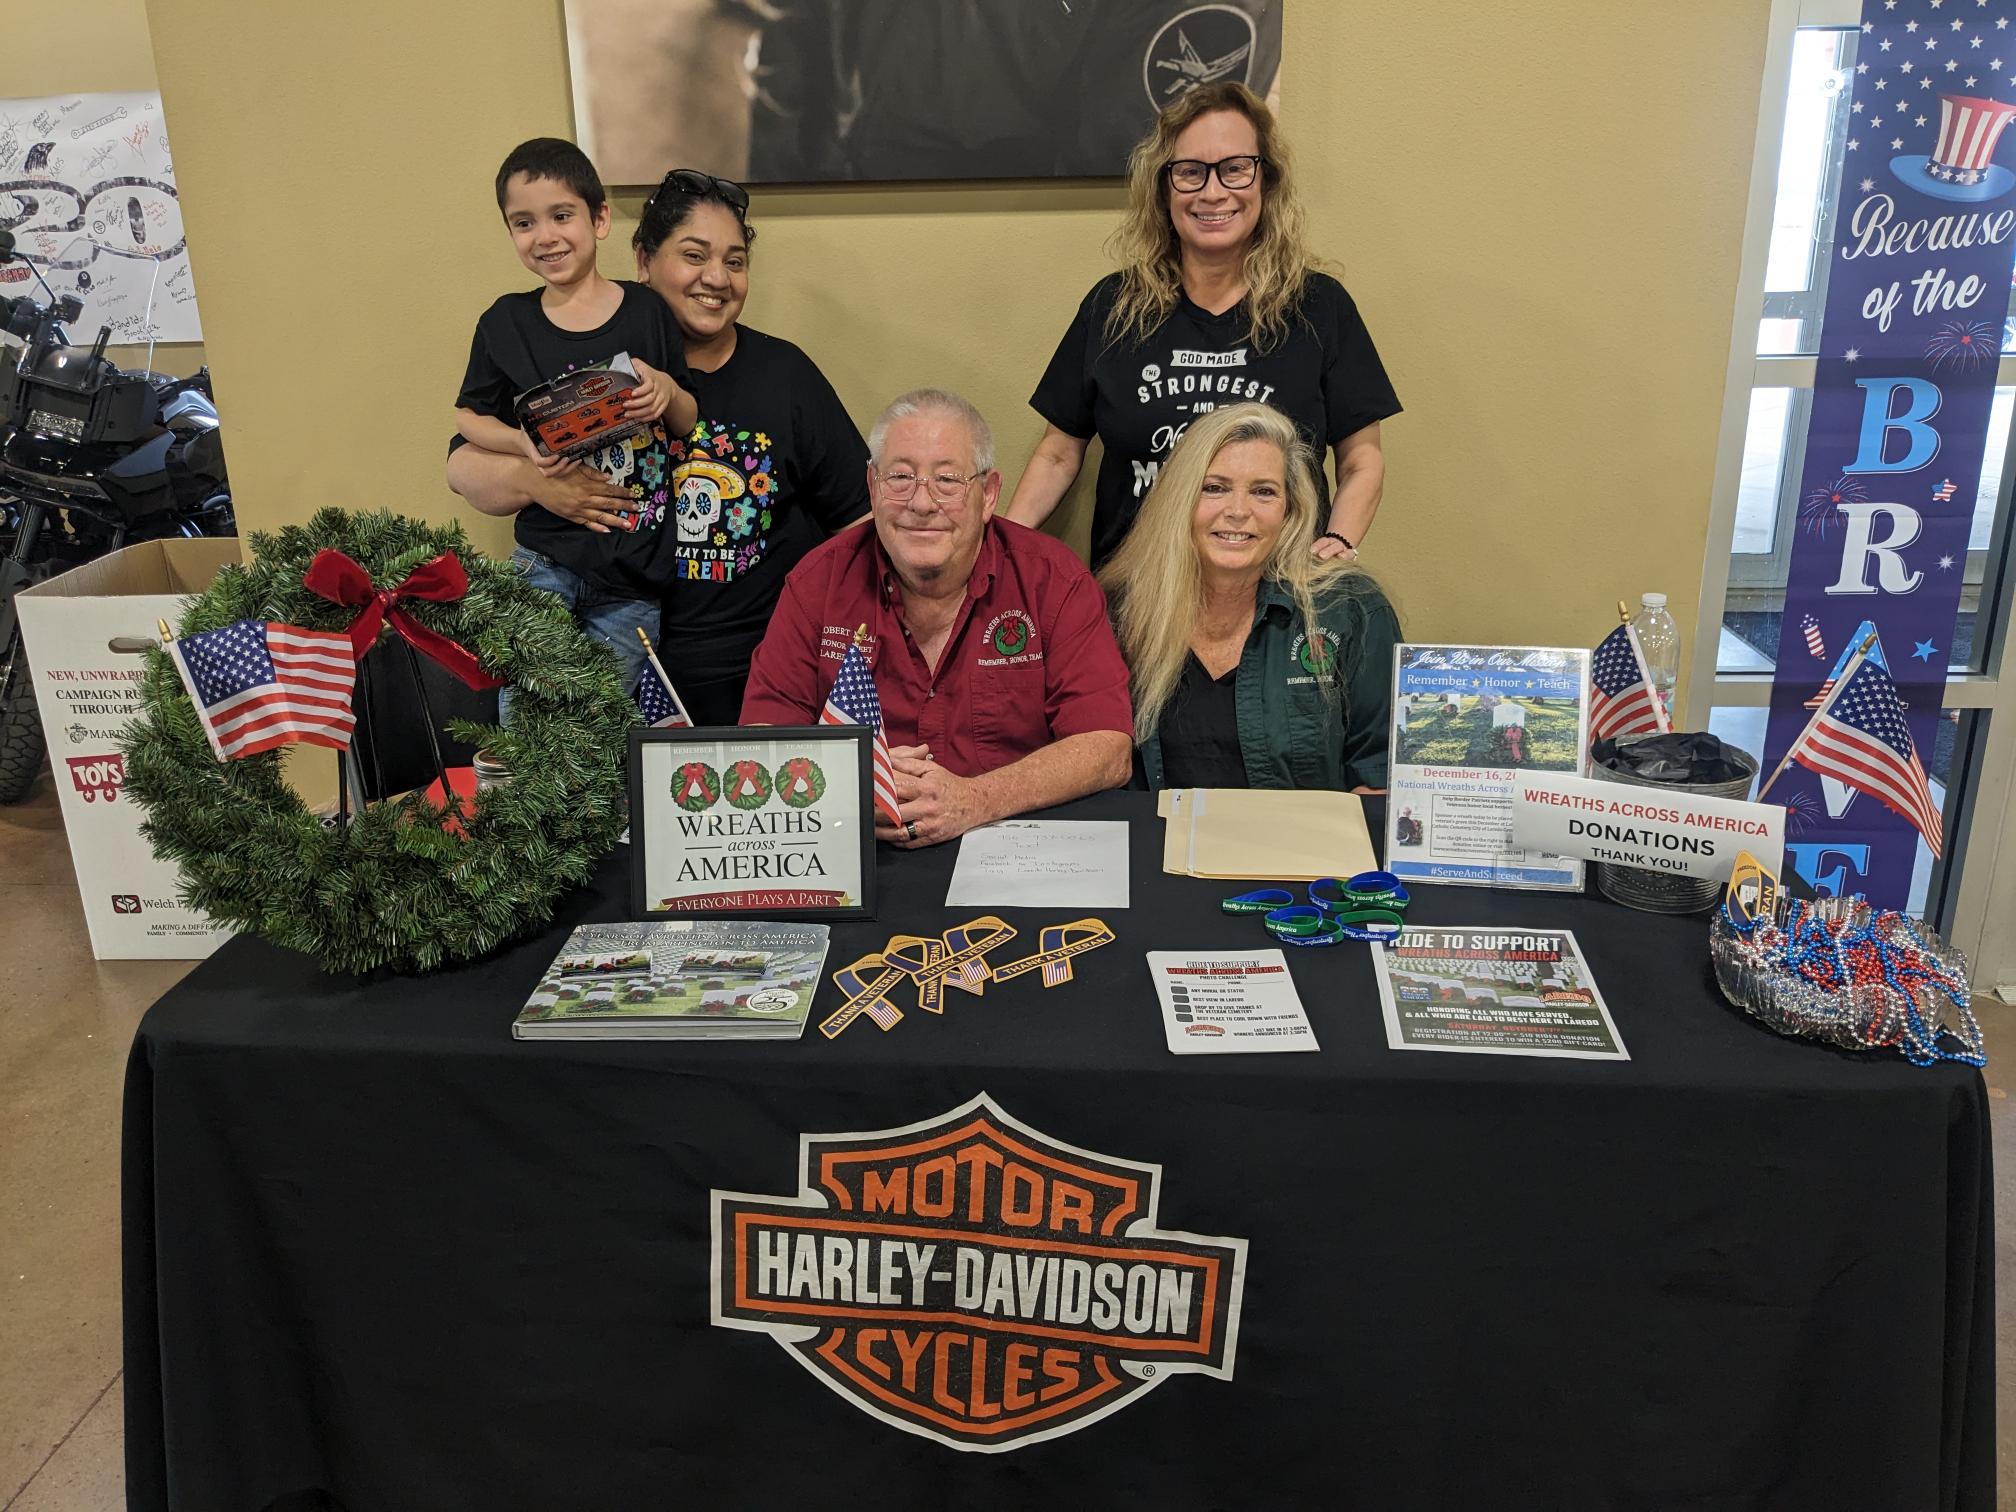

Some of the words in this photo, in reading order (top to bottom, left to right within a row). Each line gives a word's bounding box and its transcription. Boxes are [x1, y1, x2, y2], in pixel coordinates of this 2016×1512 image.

[1841, 194, 2016, 260] Because
[1862, 276, 1903, 332] of
[1911, 268, 1986, 317] the
[1180, 352, 1203, 365] GOD
[1205, 352, 1238, 365] MADE
[1144, 369, 1158, 377] THE
[1137, 374, 1275, 404] STRONGEST
[1192, 402, 1214, 414] AND
[675, 546, 699, 559] KAY
[703, 549, 717, 560] TO
[720, 549, 735, 560] BE
[676, 559, 735, 582] ERENT
[823, 626, 850, 637] OBERT
[983, 616, 1000, 644] WREATHS
[1000, 609, 1022, 620] ACROSS
[1021, 614, 1036, 638] AMERICA
[821, 639, 847, 650] HONOR
[820, 649, 845, 661] LARE
[1029, 651, 1043, 661] TEAC
[1408, 650, 1447, 669] Join
[1470, 653, 1485, 665] in
[47, 670, 79, 682] NEW,
[1407, 675, 1468, 686] Remember
[1484, 677, 1520, 688] Honor
[1537, 679, 1570, 690] Teach
[56, 689, 121, 700] CAMPAIGN
[125, 689, 141, 700] RU
[70, 704, 133, 715] THROUGH
[89, 729, 130, 739] MARIN
[673, 746, 713, 755] REMEMBER
[730, 744, 761, 752] HONOR
[73, 761, 123, 786] TOYS
[1423, 767, 1481, 780] December
[1485, 770, 1501, 781] 16,
[1397, 780, 1435, 790] National
[1437, 781, 1476, 792] Wreaths
[1478, 783, 1508, 793] Across
[1524, 789, 1605, 812] WREATHS
[1609, 801, 1680, 824] ACROSS
[1684, 813, 1769, 837] AMERICA
[676, 810, 822, 838] WREATHS
[727, 838, 776, 852] across
[1569, 819, 1716, 857] DONATIONS
[676, 852, 828, 882] AMERICA
[1591, 847, 1646, 865] THANK
[1649, 856, 1689, 872] YOU!
[143, 899, 175, 909] Welch
[677, 894, 743, 911] EVERYONE
[748, 893, 784, 905] PLAYS
[786, 893, 796, 905] A
[799, 892, 831, 906] PART
[1441, 934, 1464, 949] TO
[1470, 935, 1561, 952] SUPPORT
[920, 959, 957, 977] THANK
[964, 933, 1011, 956] VETERAN
[1002, 957, 1044, 975] THANK
[1053, 937, 1108, 957] VETERAN
[1397, 948, 1450, 958] WREATHS
[1455, 949, 1500, 960] ACROSS
[1503, 951, 1558, 961] AMERICA
[828, 1004, 861, 1028] THANK
[863, 970, 901, 1000] VETERAN
[1426, 1006, 1471, 1014] HONORING
[1414, 1028, 1469, 1036] REGISTRATION
[863, 1142, 1093, 1234] MOTOR
[758, 1230, 1193, 1335] HARLEY-DAVIDSON
[856, 1328, 1080, 1418] CYCLES
